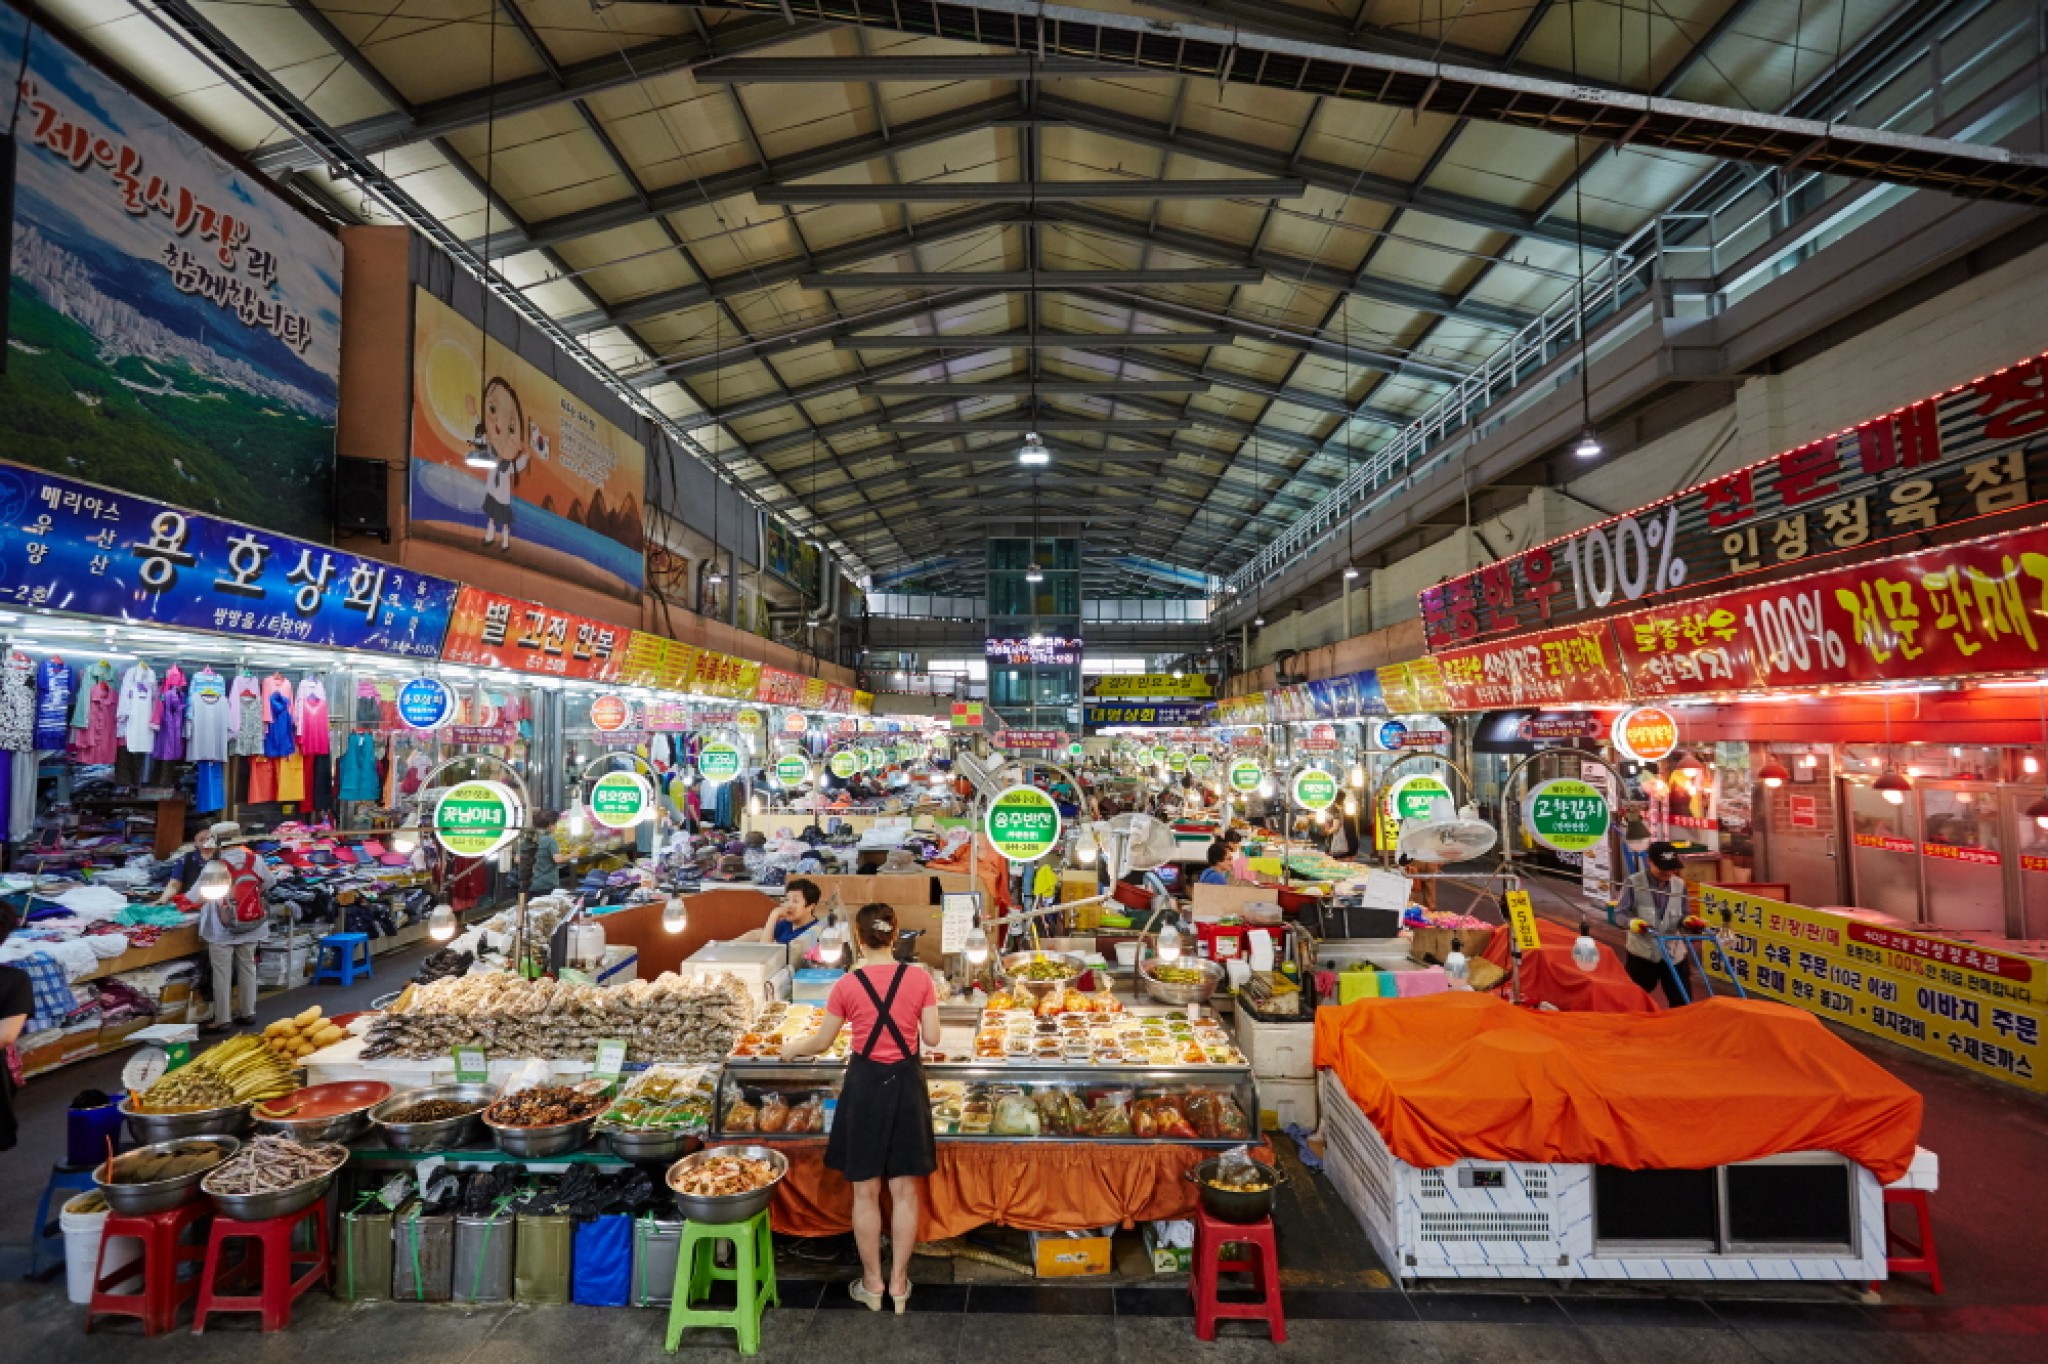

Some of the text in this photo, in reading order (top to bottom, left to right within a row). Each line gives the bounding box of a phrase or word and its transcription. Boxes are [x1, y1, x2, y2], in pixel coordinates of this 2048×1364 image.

[162, 241, 311, 353] 함께합니다
[1722, 449, 2029, 574] 인성정육점
[132, 511, 386, 622] 용호상회
[1563, 504, 1688, 608] 100%
[1633, 608, 1738, 652] 토종한우
[1744, 588, 1846, 673] 100%
[1536, 798, 1603, 820] 고창김치
[1756, 964, 1786, 994] 판매
[1871, 1005, 1927, 1042] 돼지갈비
[1797, 951, 1829, 981] 주문
[1917, 986, 2040, 1047] 이바지 주문
